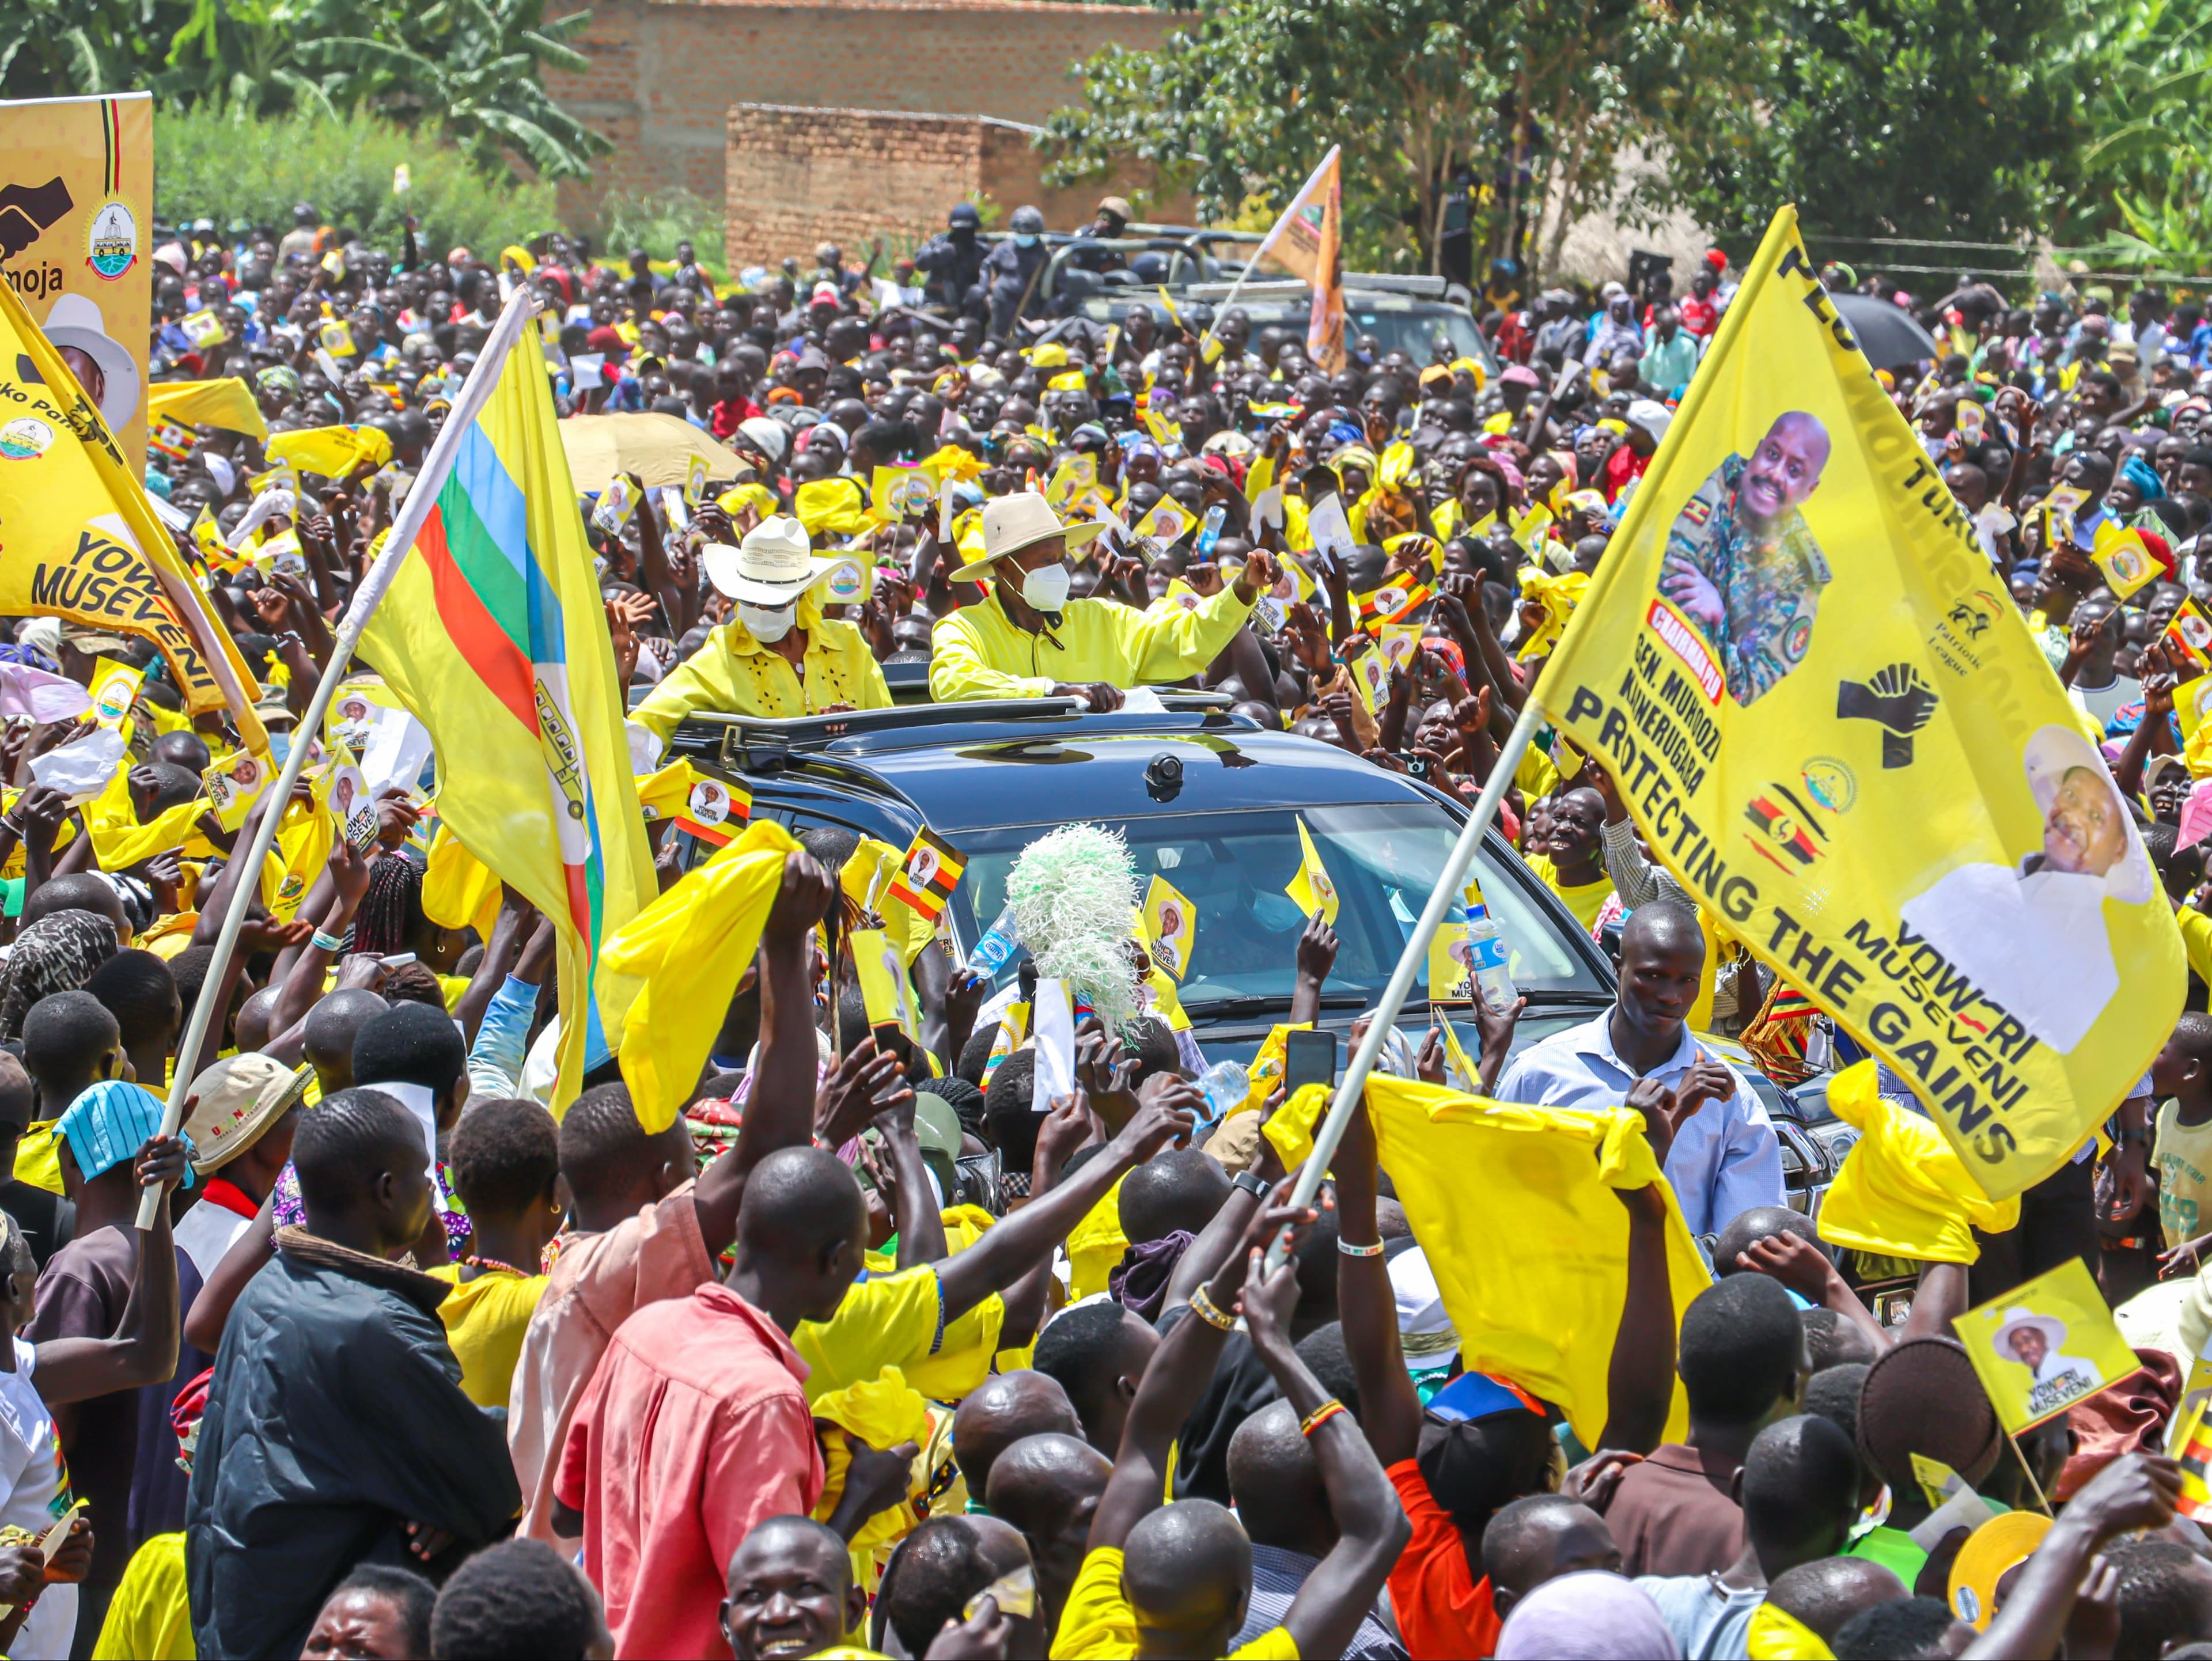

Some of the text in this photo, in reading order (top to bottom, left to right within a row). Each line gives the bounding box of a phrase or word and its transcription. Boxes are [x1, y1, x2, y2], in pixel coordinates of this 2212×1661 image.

[6, 261, 63, 300] moja
[32, 563, 217, 689] MUSEVENI
[1258, 597, 1279, 619] OWERI
[1928, 637, 1968, 677] League
[1936, 622, 1984, 671] Patriotic
[1660, 669, 1722, 764] MUHOOZI
[347, 803, 372, 833] OWERI
[694, 808, 719, 822] MUSEVENI
[698, 805, 717, 816] YOWERI
[1565, 684, 2017, 1165] PROTECTING THE GAINS
[1151, 942, 1176, 969] MUSEVENI
[1155, 937, 1175, 960] YOWERI
[1895, 919, 2040, 1065] YOWERI
[1844, 917, 2029, 1112] MUSEVENI
[2029, 1376, 2094, 1416] MUSEVENI
